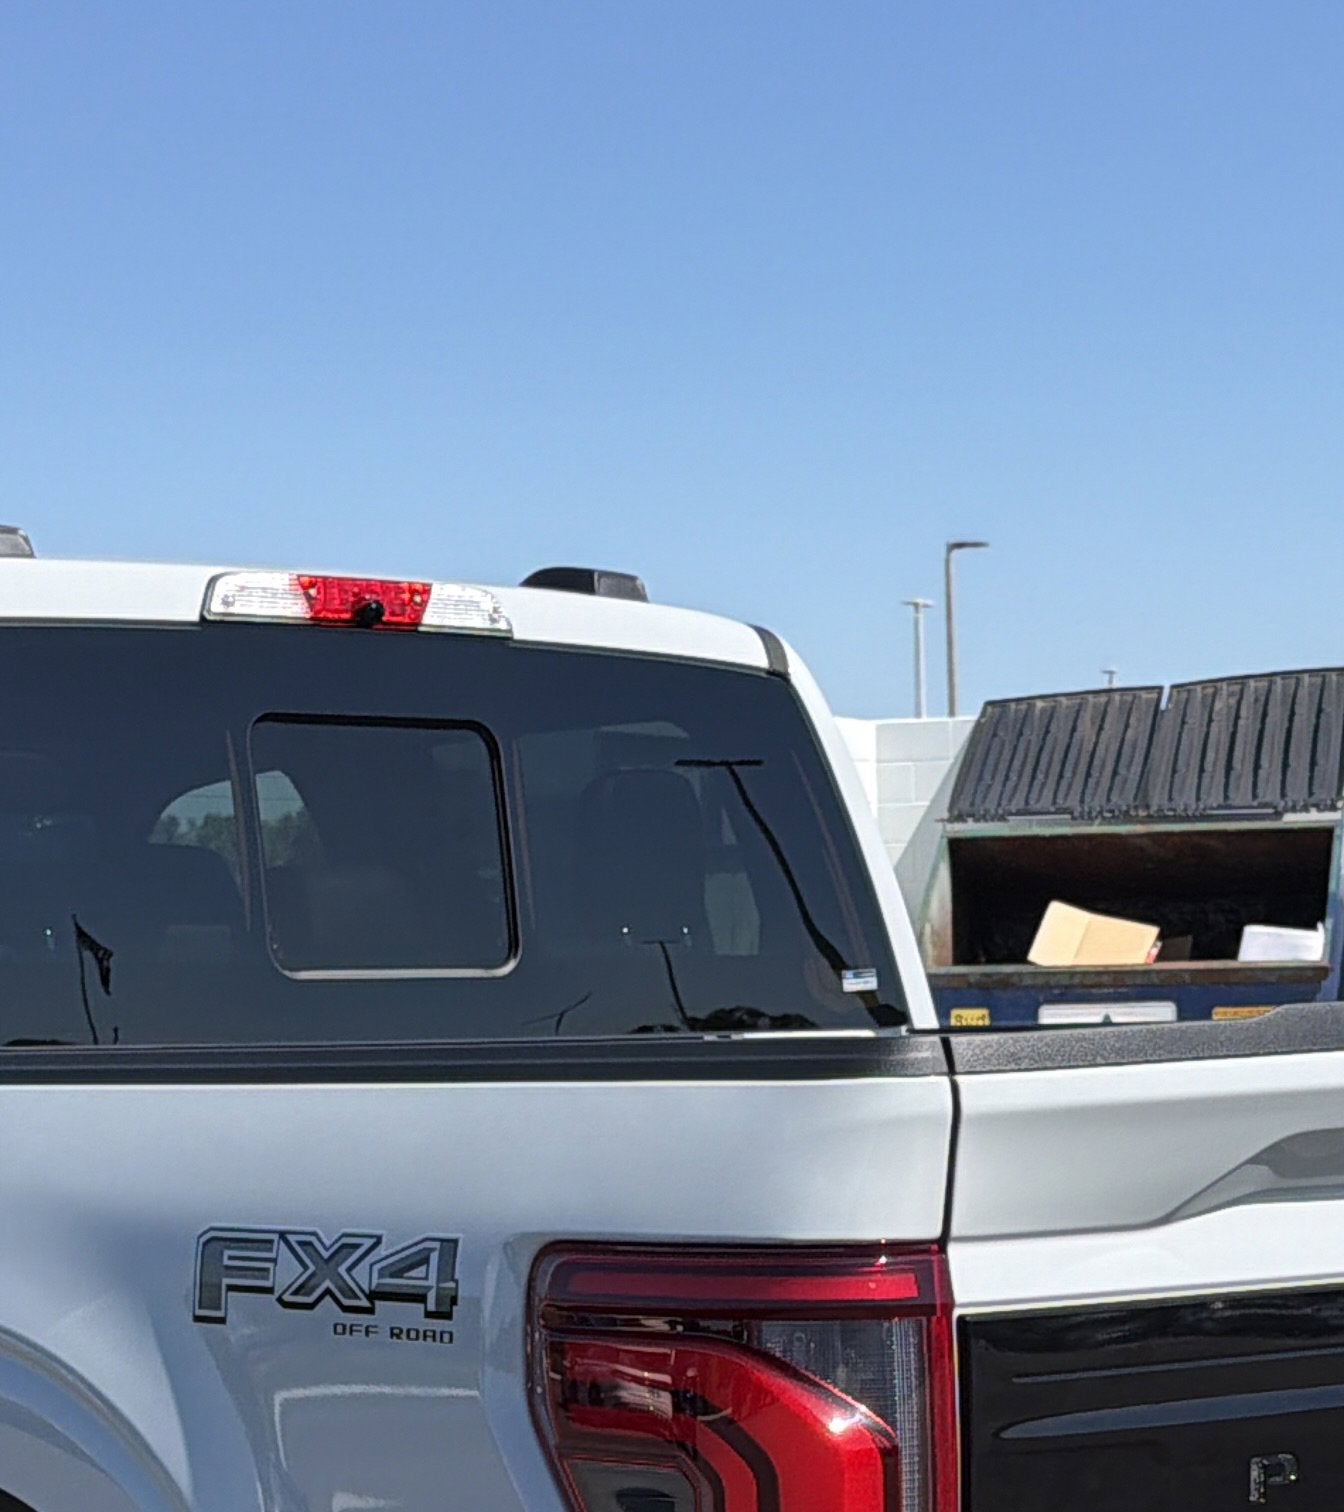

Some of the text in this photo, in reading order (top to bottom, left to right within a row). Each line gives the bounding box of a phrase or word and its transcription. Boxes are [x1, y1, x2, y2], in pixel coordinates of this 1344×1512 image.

[193, 1226, 460, 1323] FX4
[333, 1322, 453, 1344] OFF ROAD
